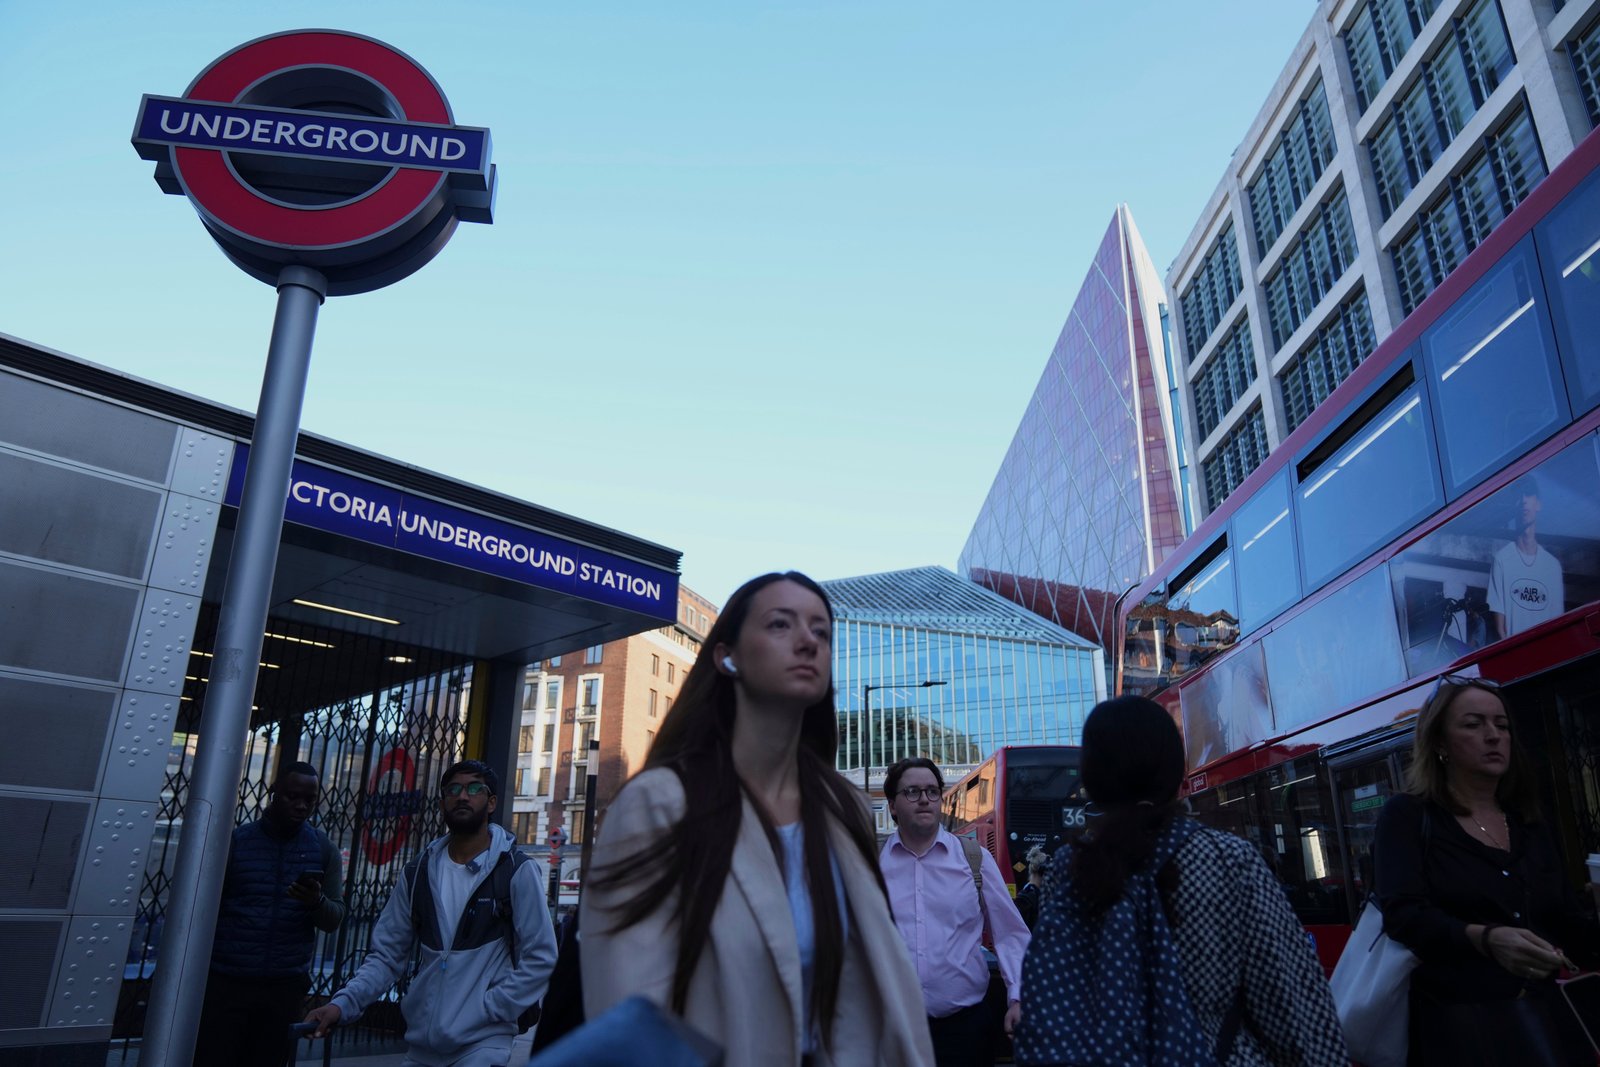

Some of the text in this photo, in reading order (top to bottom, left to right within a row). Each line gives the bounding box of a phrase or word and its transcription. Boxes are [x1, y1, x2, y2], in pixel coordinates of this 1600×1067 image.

[159, 109, 467, 161] UNDERGROUND
[286, 478, 661, 601] CTORIA UNDERGROUND STATION
[1520, 592, 1540, 603] MAX
[1523, 586, 1538, 596] AIR
[1063, 808, 1086, 826] 36
